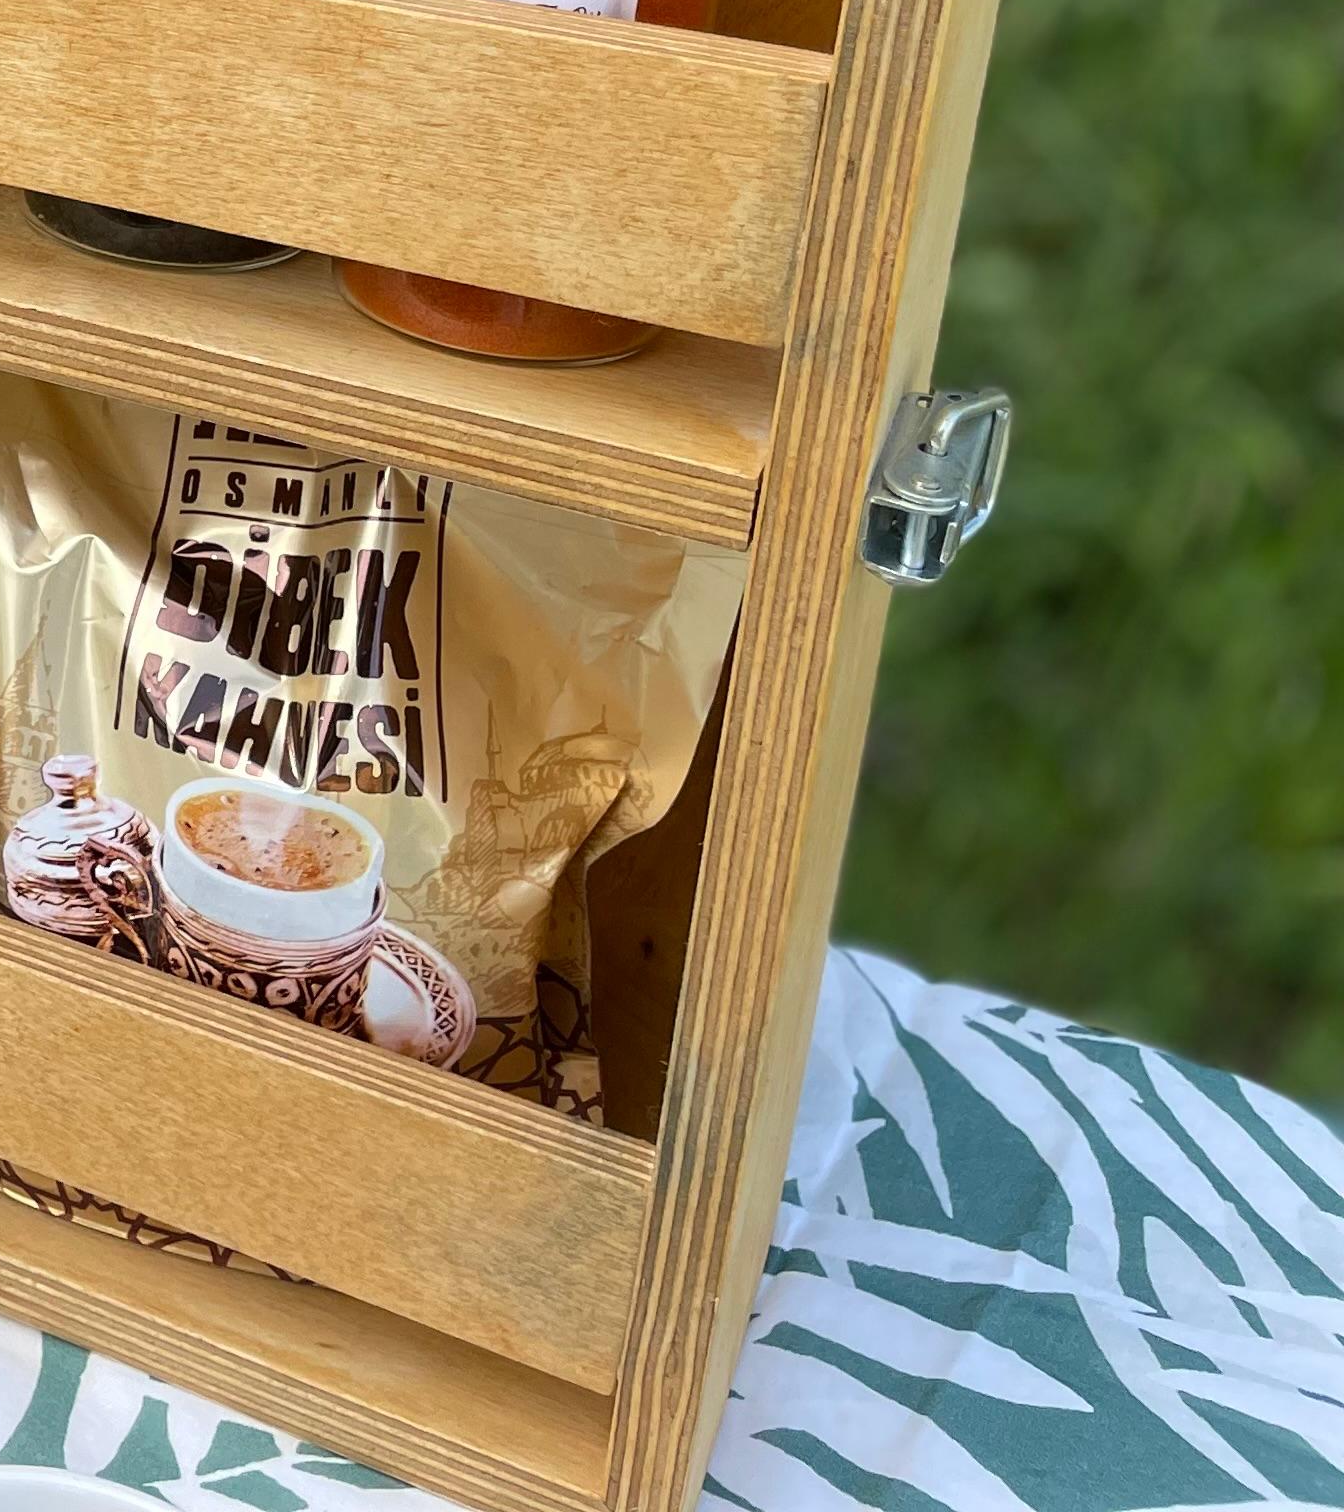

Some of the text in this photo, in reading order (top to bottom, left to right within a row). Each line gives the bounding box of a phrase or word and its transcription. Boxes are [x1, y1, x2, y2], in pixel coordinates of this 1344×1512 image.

[180, 467, 429, 518] OSMANLI
[155, 524, 421, 680] DİBEK
[134, 652, 425, 797] KAHVESİ
